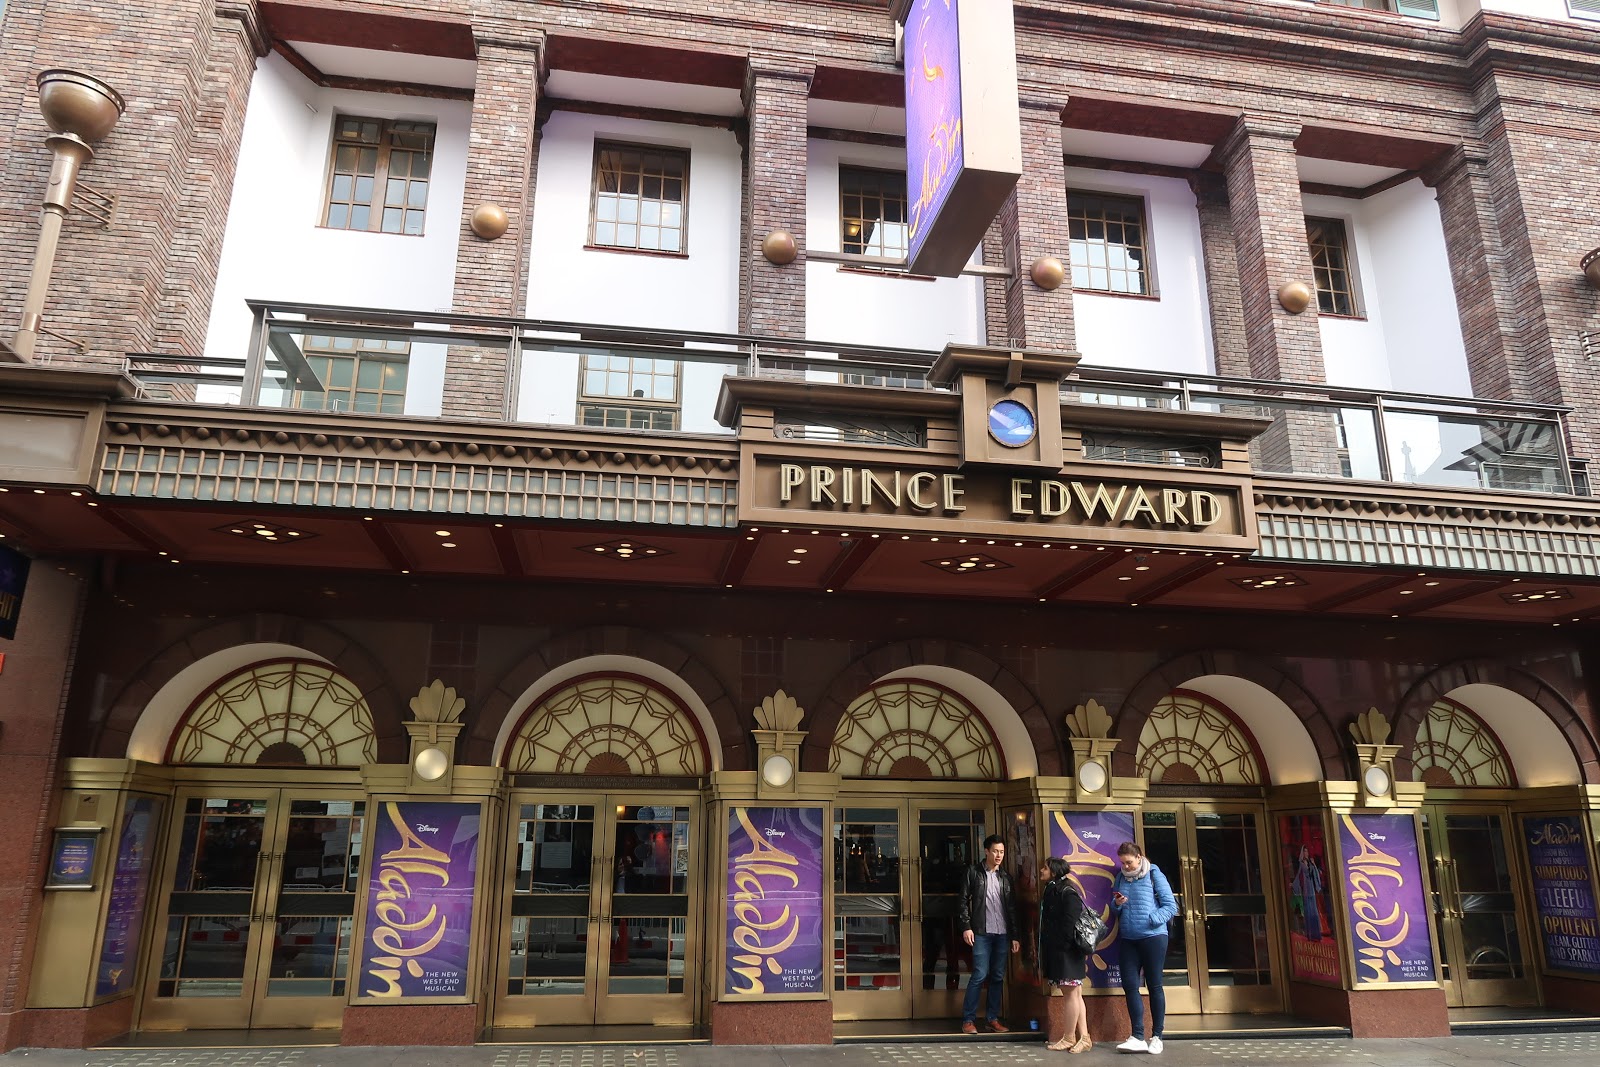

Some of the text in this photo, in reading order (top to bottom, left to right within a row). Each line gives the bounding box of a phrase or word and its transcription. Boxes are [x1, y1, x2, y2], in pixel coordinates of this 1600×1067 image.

[779, 463, 1223, 528] PRINCE EDWARD
[416, 823, 439, 834] Disney
[764, 827, 786, 837] Disney
[1081, 830, 1102, 840] Disney
[1367, 832, 1386, 842] Disney
[1530, 822, 1581, 845] Aladdin
[1535, 865, 1588, 881] SUMPTUOUS
[366, 802, 451, 997] Aladdin
[731, 808, 799, 994] Aladdin
[1341, 814, 1410, 983] Aladdin
[1541, 888, 1592, 909] GLEEFUL
[1544, 915, 1597, 938] OPULENT
[1296, 954, 1336, 977] KNOCKOUT
